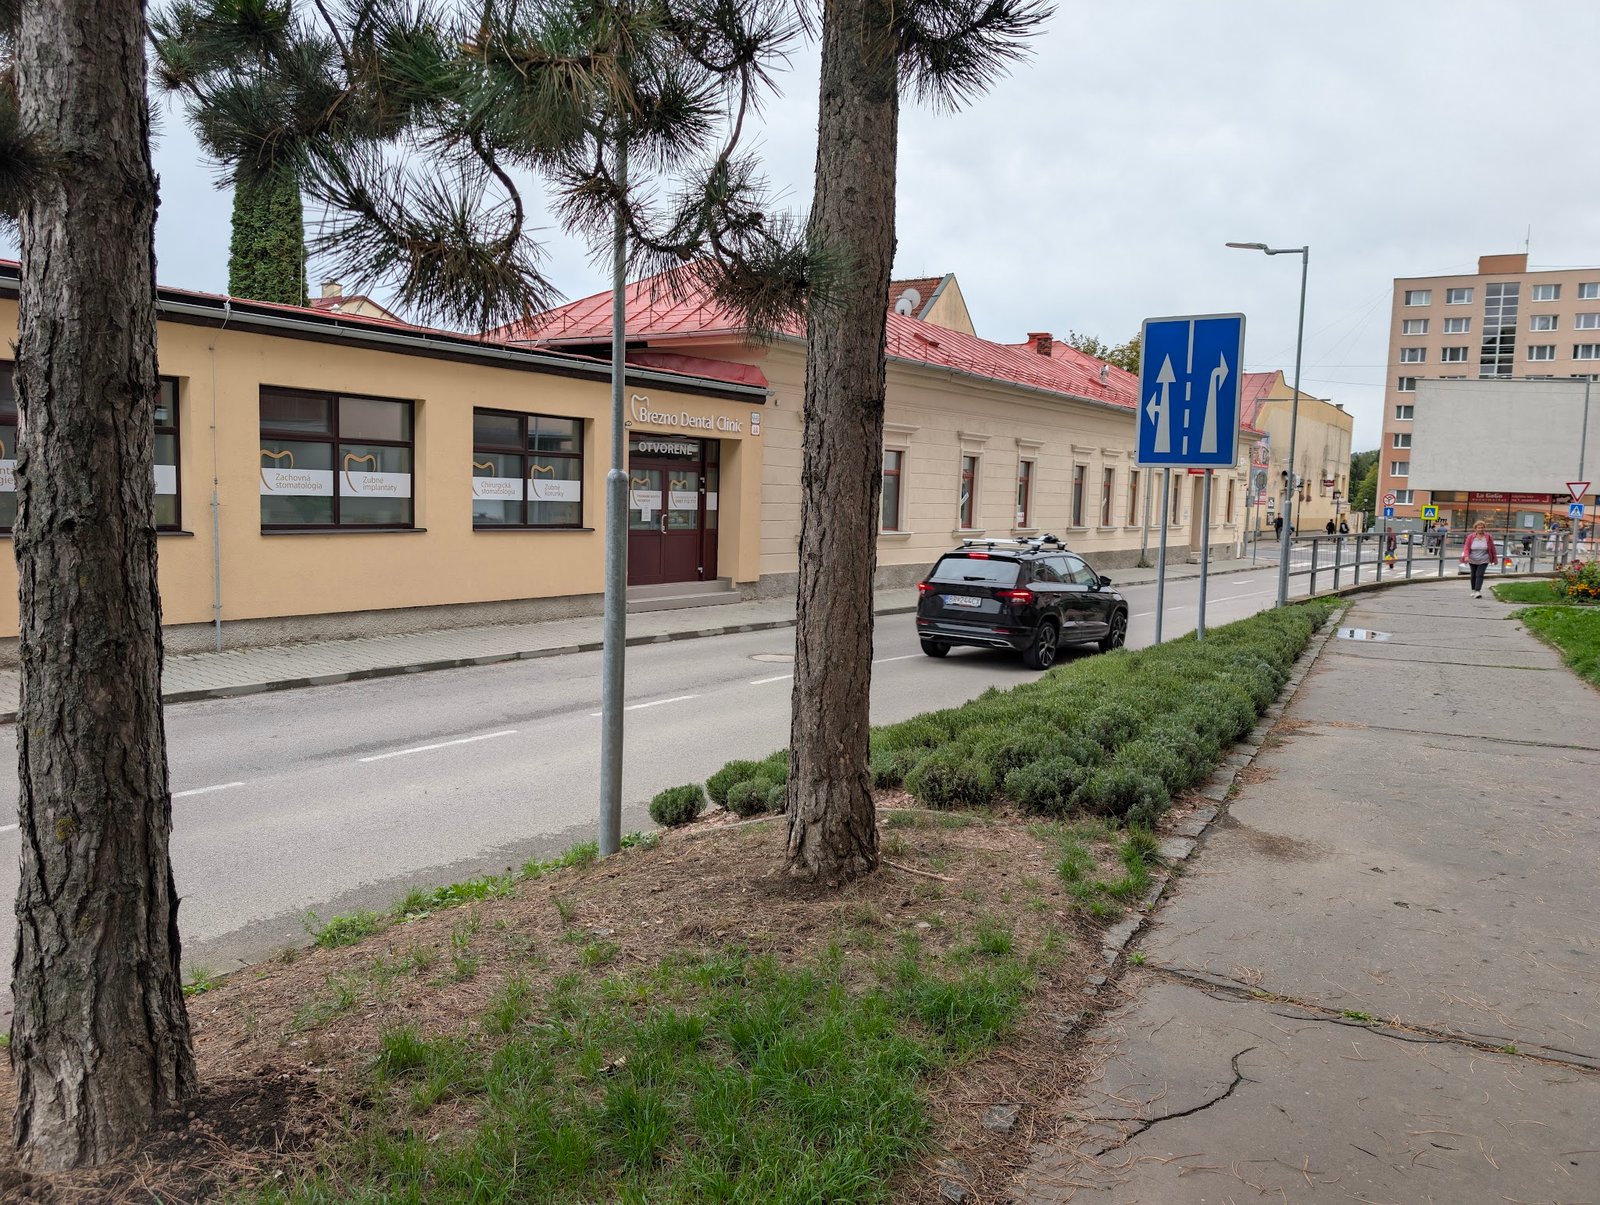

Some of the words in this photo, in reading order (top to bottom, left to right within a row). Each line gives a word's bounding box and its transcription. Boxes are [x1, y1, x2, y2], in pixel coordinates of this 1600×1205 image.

[639, 406, 678, 426] Brezno
[680, 411, 714, 430] Dental
[716, 416, 743, 432] Clinic
[275, 473, 311, 482] Zachovná
[362, 476, 384, 484] Zubné
